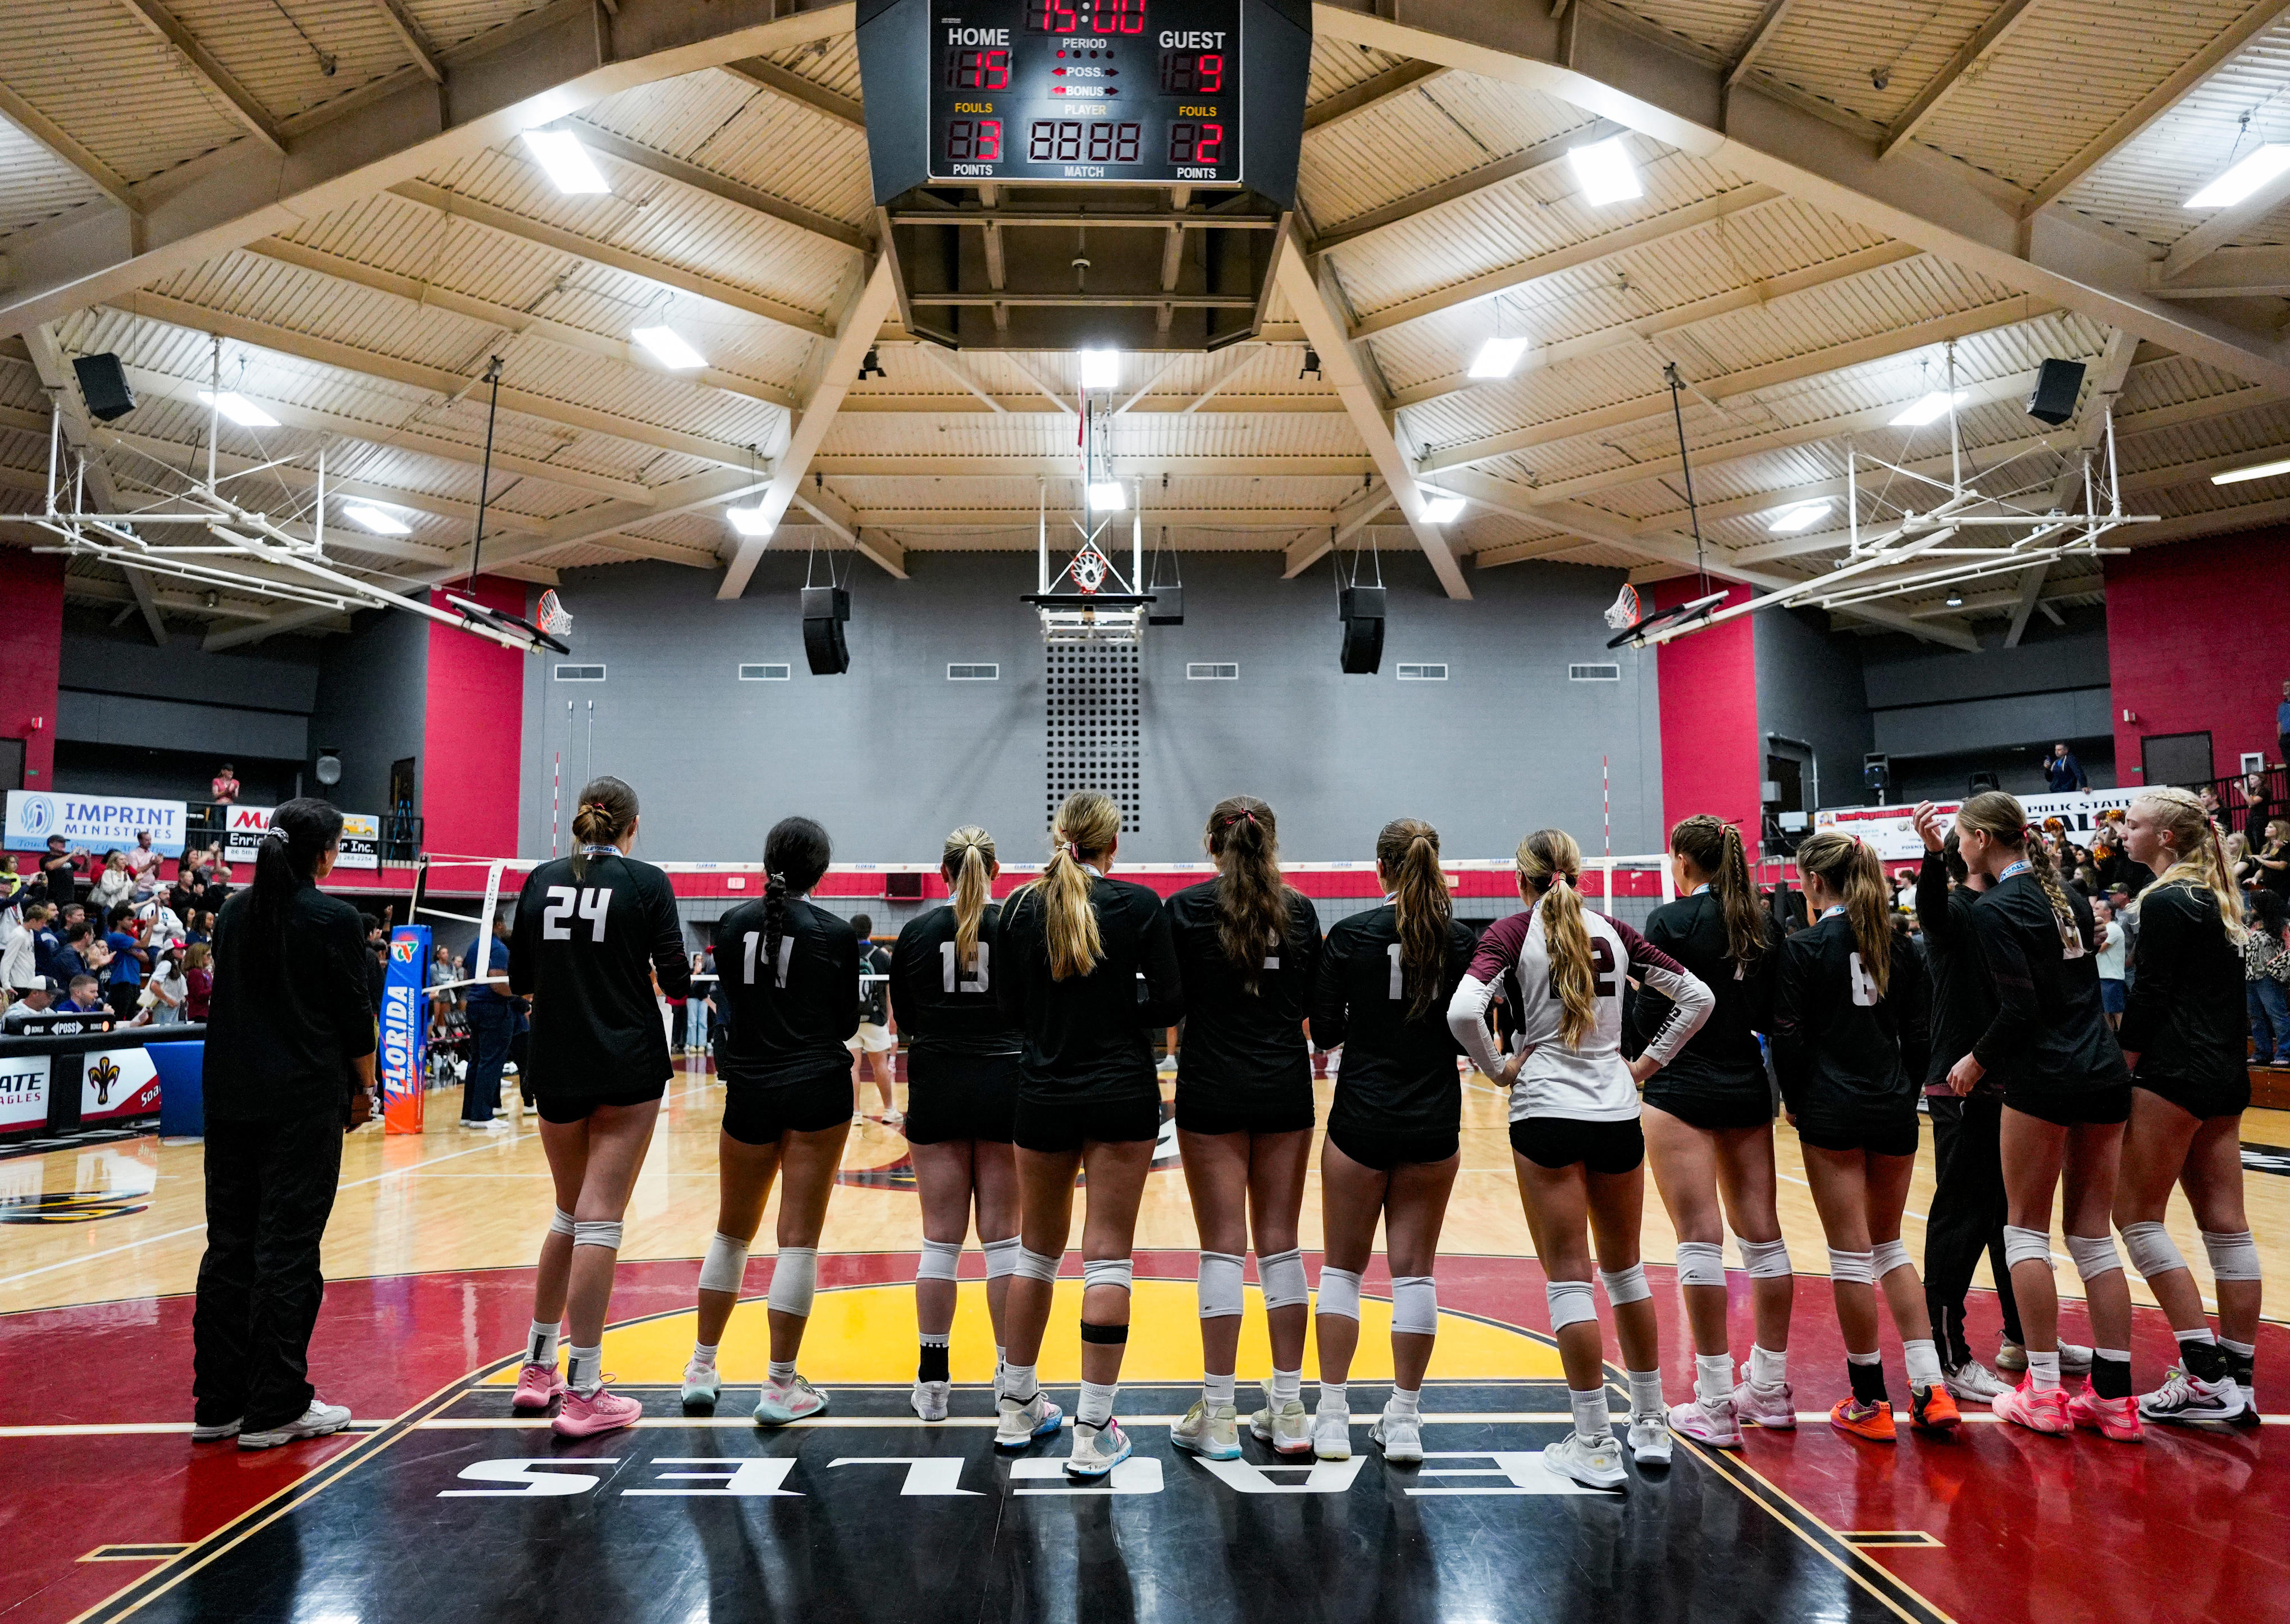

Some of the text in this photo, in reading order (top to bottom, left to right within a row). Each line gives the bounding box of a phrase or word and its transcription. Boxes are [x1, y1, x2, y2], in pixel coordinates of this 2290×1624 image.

[948, 28, 1010, 46] HOME
[1062, 38, 1107, 48] PERIOD
[1159, 30, 1226, 49] GUEST
[974, 50, 1008, 89] 15
[1066, 67, 1105, 77] POSS.
[1198, 54, 1222, 92] 9
[1066, 85, 1105, 97] BONUS
[955, 102, 993, 113] FOULS
[1065, 104, 1107, 115] PLAYER
[1179, 106, 1217, 117] FOULS
[977, 120, 1001, 160] 3
[1196, 124, 1223, 163] 2
[953, 164, 993, 176] POINTS
[1064, 166, 1105, 177] MATCH
[1176, 167, 1217, 179] POINTS
[65, 802, 175, 826] IMPRINT
[2028, 799, 2132, 813] POLK STATE
[350, 840, 374, 854] Inc.
[543, 885, 613, 942] 24
[743, 931, 795, 988] 14
[58, 1022, 76, 1034] POSS
[385, 986, 409, 1094] FLORIDA
[141, 1084, 161, 1108] Soa
[436, 1452, 1624, 1497] EAGLES
